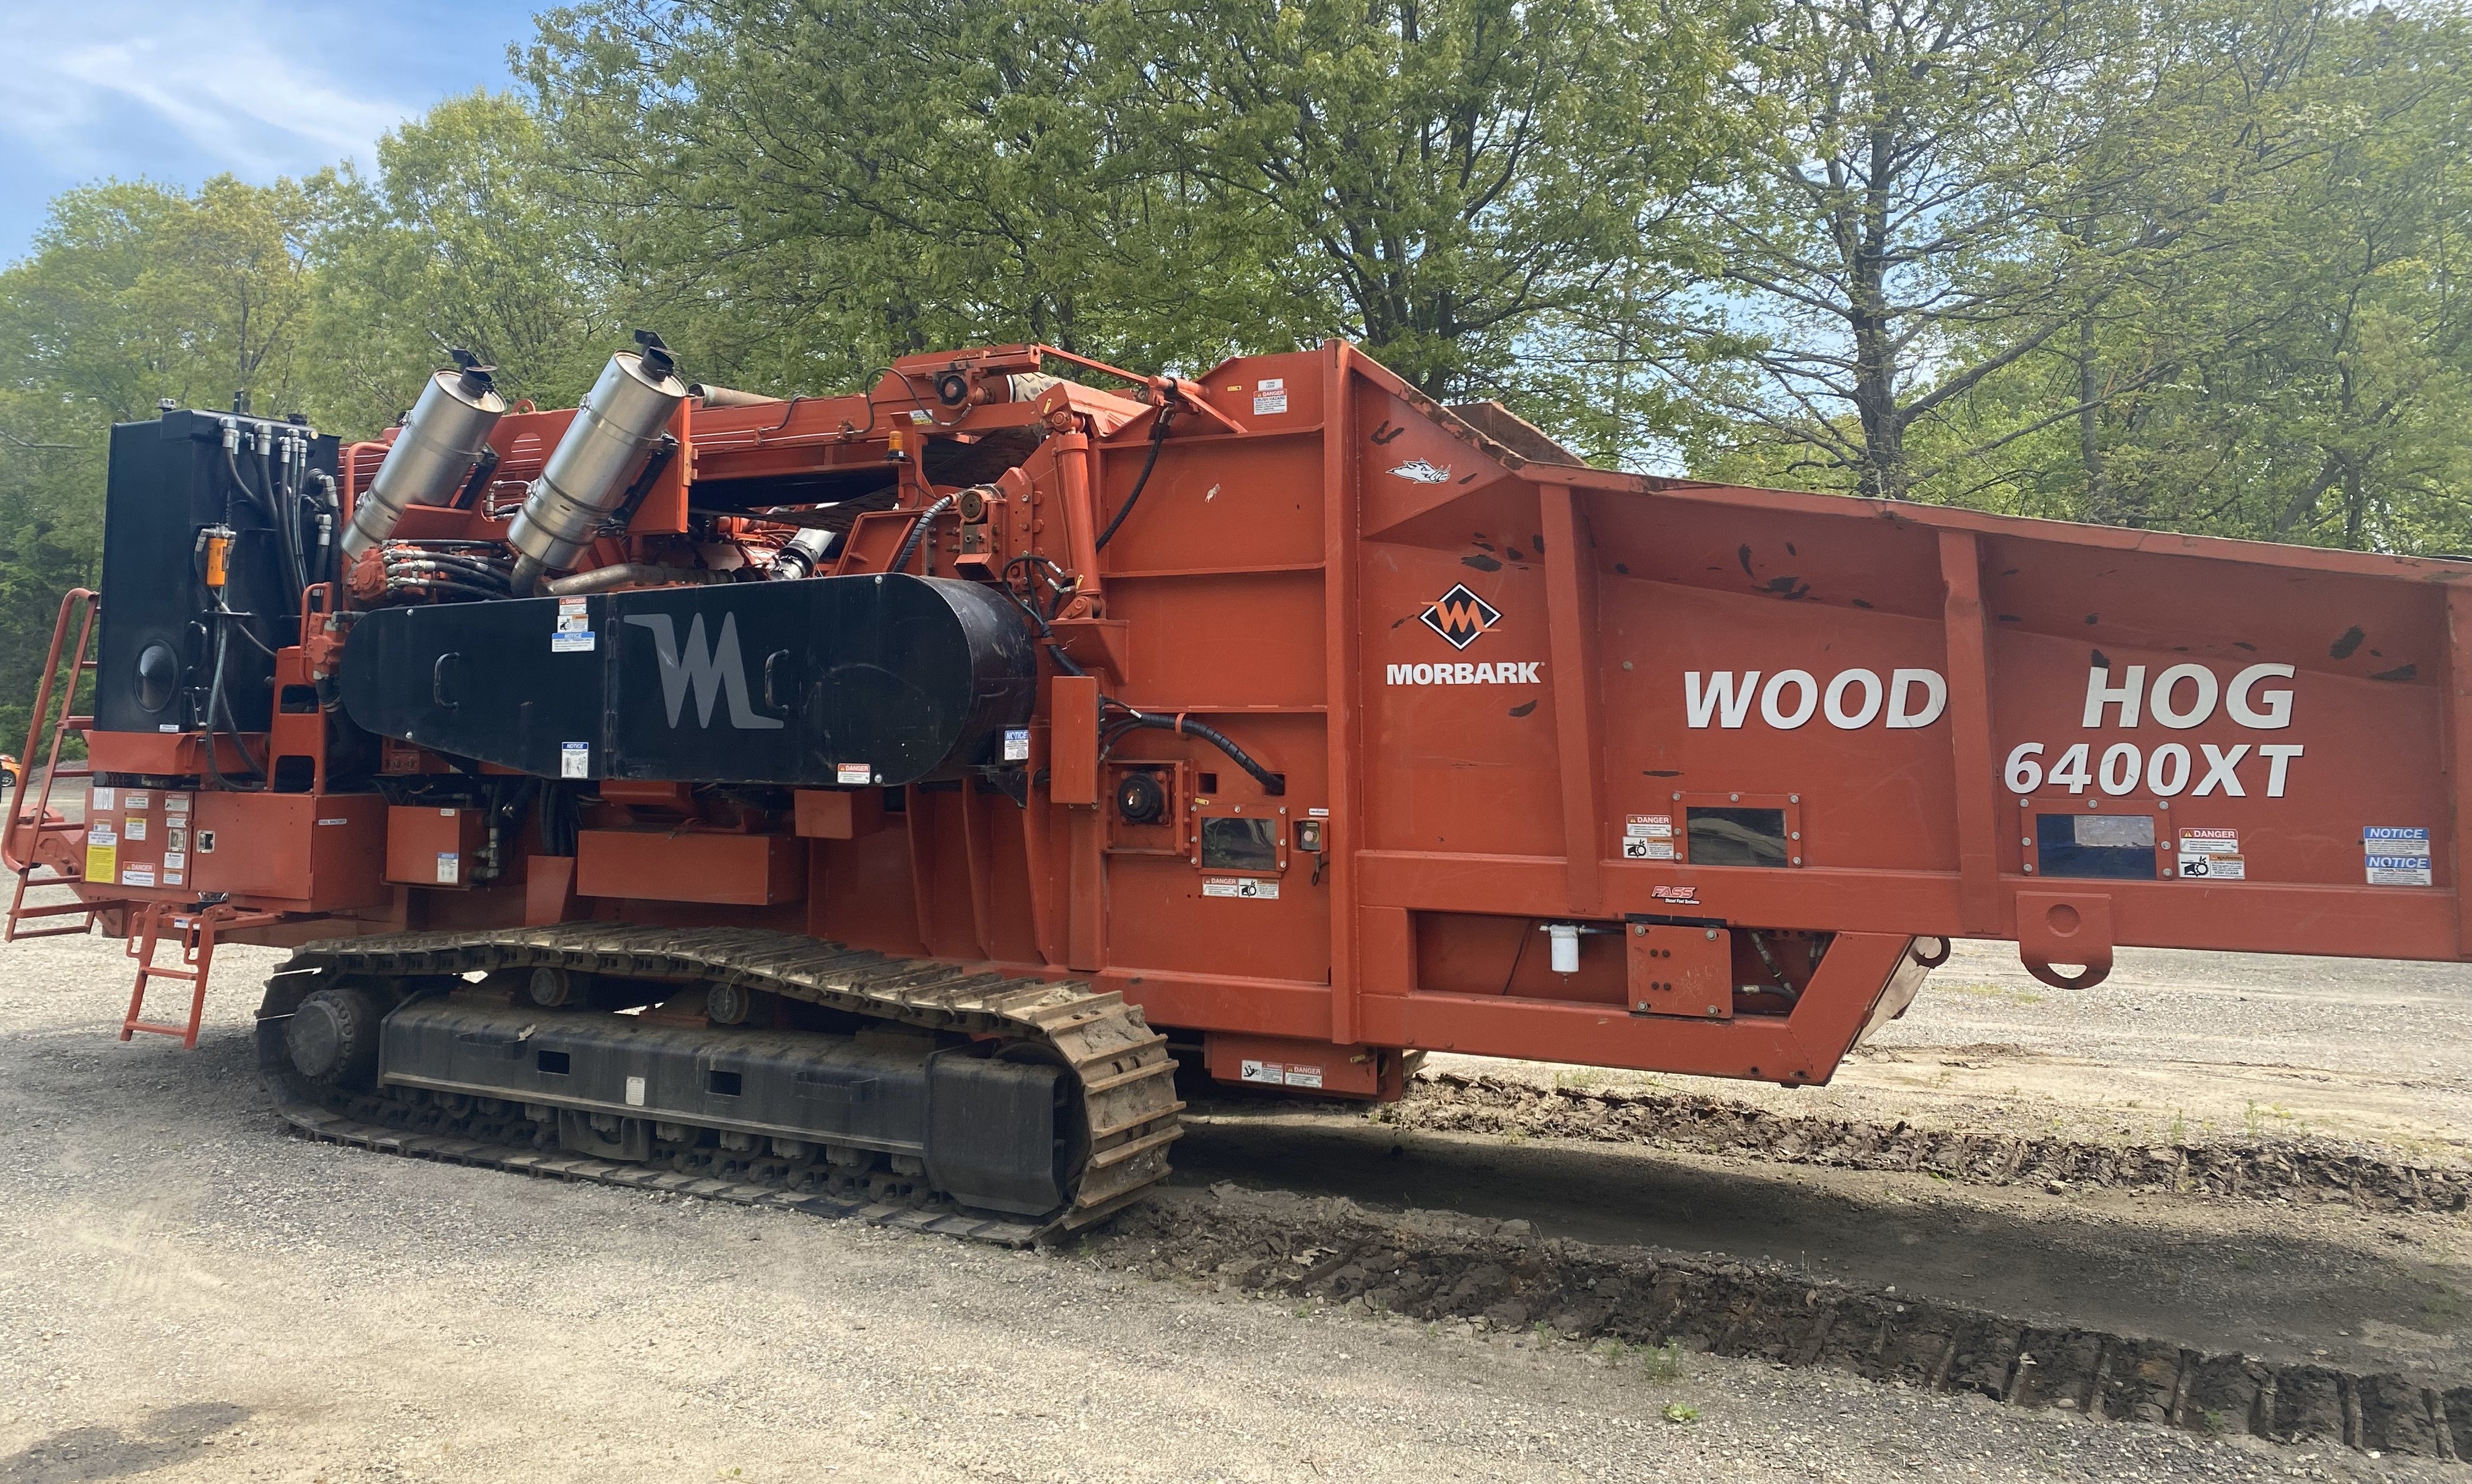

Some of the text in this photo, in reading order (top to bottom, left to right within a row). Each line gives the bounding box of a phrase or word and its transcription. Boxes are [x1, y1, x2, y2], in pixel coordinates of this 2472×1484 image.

[1386, 662, 1541, 685] MORBARK
[1684, 662, 2296, 729] WOOD HOG
[1006, 731, 1027, 740] NOTICE
[2004, 742, 2304, 798] 6400XT
[2370, 828, 2423, 839] NOTICE
[2369, 857, 2428, 868] NOTICE
[1651, 886, 1696, 898] FASS
[1294, 1066, 1320, 1075] DANGER
